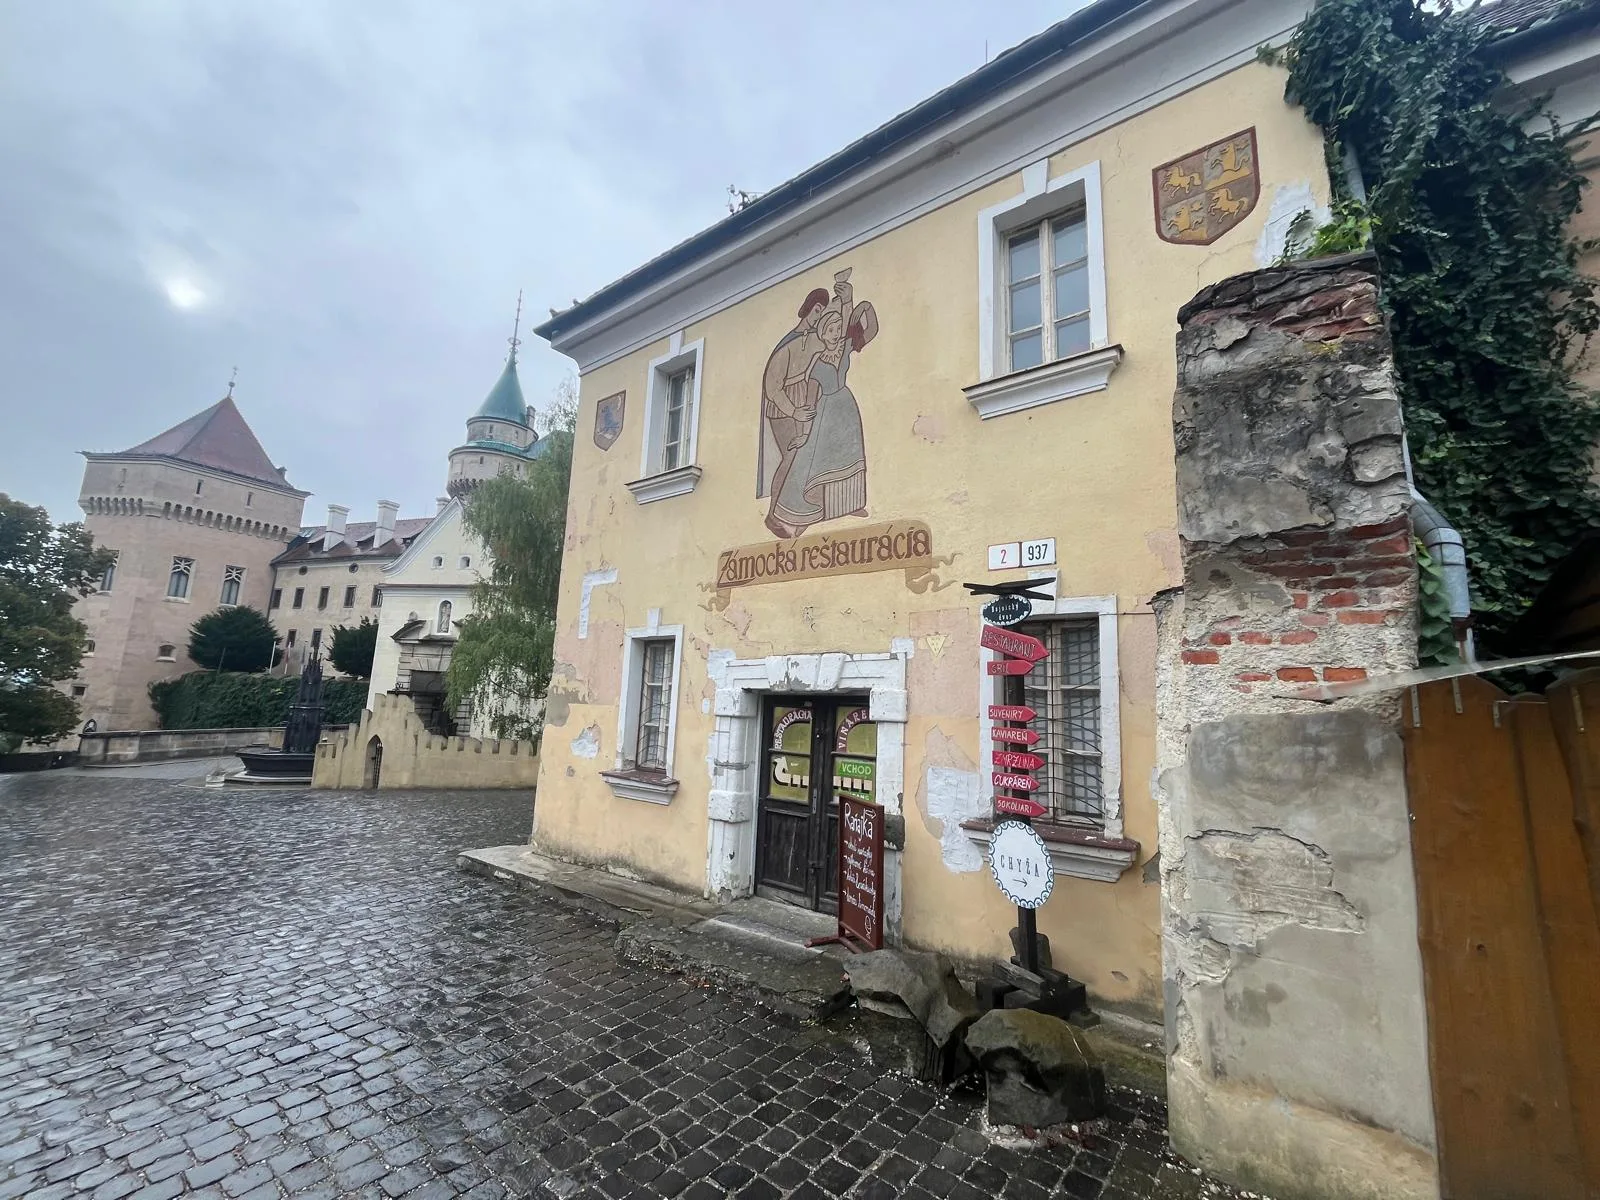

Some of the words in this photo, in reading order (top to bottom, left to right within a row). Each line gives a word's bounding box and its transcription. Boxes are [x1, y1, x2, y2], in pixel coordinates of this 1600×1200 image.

[717, 539, 797, 588] Zámocká
[800, 524, 931, 572] reštaurácia
[1000, 549, 1007, 564] 2
[1028, 543, 1048, 561] 937
[982, 630, 1036, 658] RESTAURANT
[991, 663, 1008, 674] GRIL
[992, 729, 1028, 741] KAVIAREŇ
[841, 762, 872, 775] VCHOD
[997, 799, 1033, 813] SOKOLIARI
[1000, 854, 1040, 878] CHYŽA
